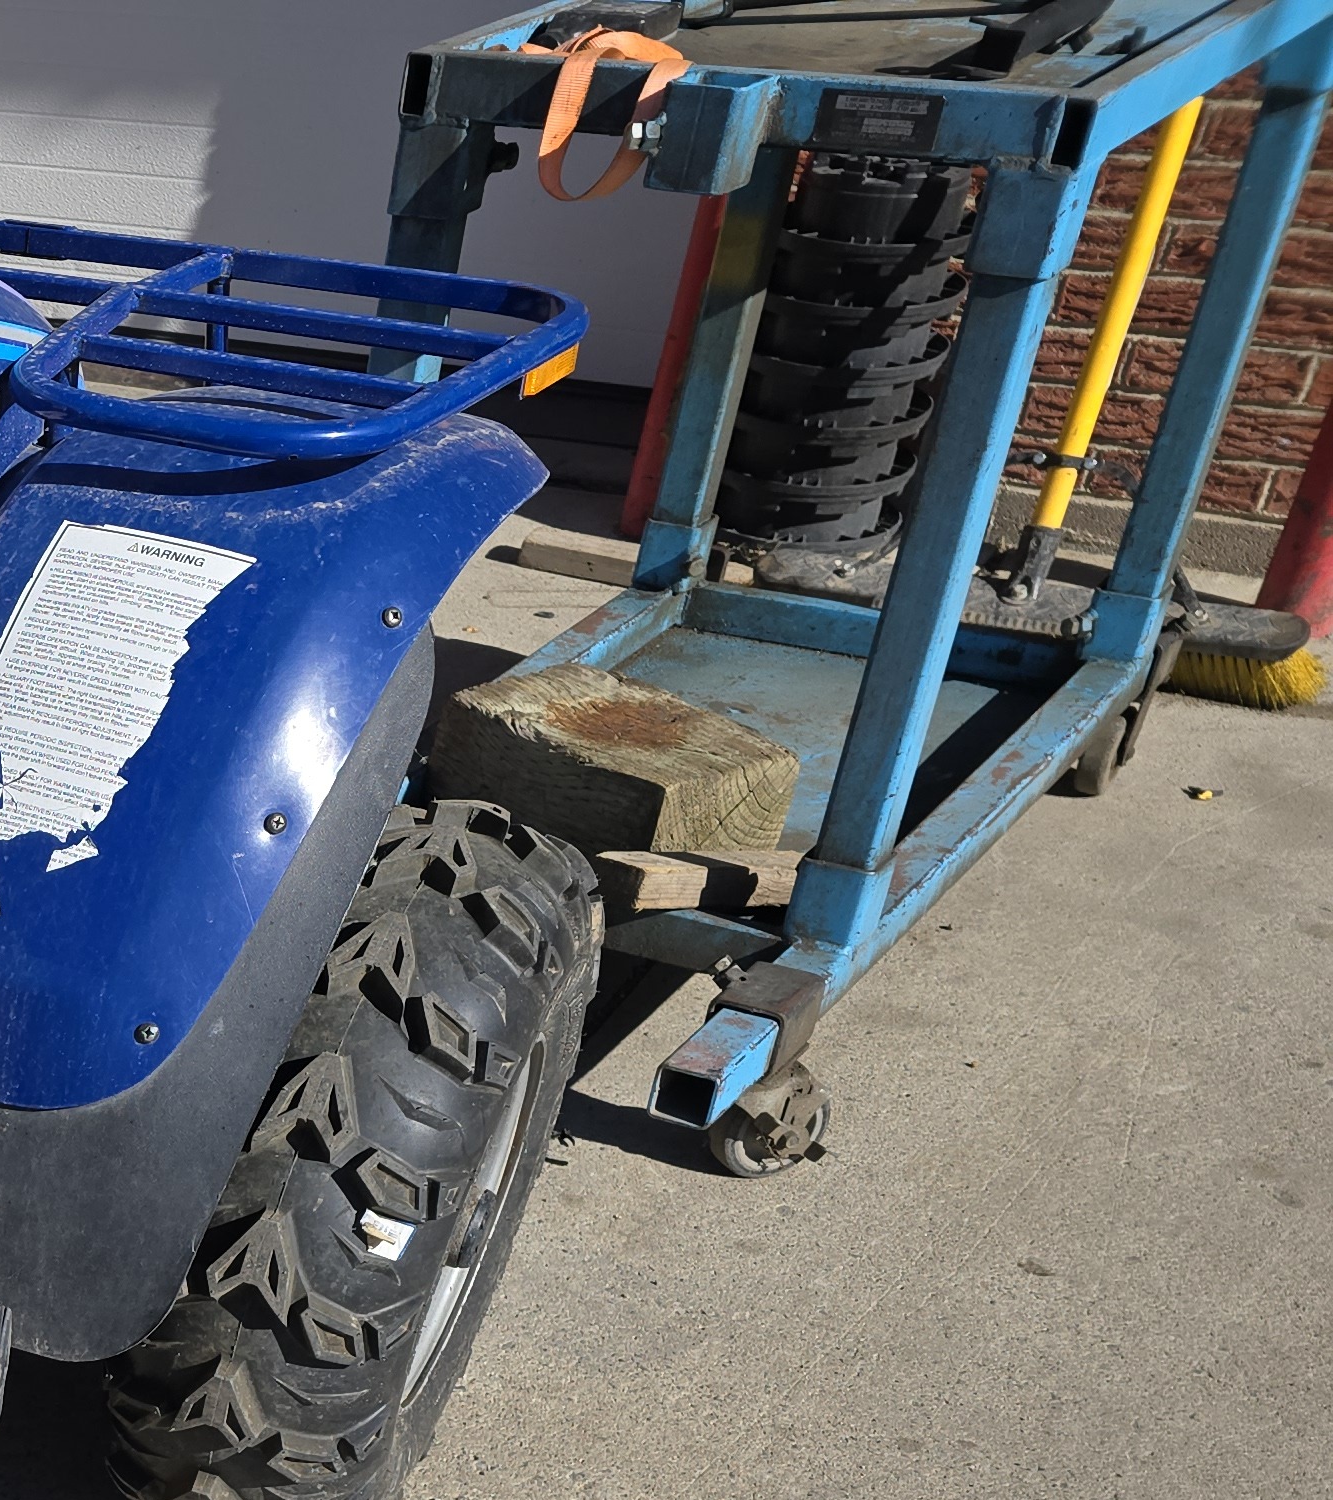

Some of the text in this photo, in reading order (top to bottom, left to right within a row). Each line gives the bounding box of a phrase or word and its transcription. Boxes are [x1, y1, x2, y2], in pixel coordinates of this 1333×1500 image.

[91, 553, 129, 563] UNDERSTAND
[131, 561, 162, 571] WARNINGS
[141, 546, 205, 567] WARNING
[92, 565, 122, 574] IMPROPER
[114, 563, 136, 571] INJURY
[147, 570, 167, 578] DEATH
[182, 579, 206, 588] RESULT
[28, 616, 51, 625] REDUCE
[51, 621, 70, 629] SPEED
[119, 637, 137, 645] vehicle
[47, 636, 79, 647] OPERATION
[101, 648, 138, 662] DANGEROUS
[20, 660, 49, 670] OVERRIDE
[62, 670, 90, 680] REVERSE
[90, 676, 110, 685] SPEED
[110, 681, 134, 691] LIMITER
[134, 687, 150, 695] WITH
[17, 706, 36, 715] BRAKE
[36, 711, 65, 722] REQUIRES
[65, 718, 93, 729] PERIODIC
[4, 726, 28, 736] REQUIRE
[30, 733, 57, 744] PERIODIC
[94, 751, 118, 760] including
[20, 747, 39, 756] RELAX
[84, 764, 101, 773] LONG
[53, 781, 72, 789] WARM
[72, 786, 100, 797] WEATHER
